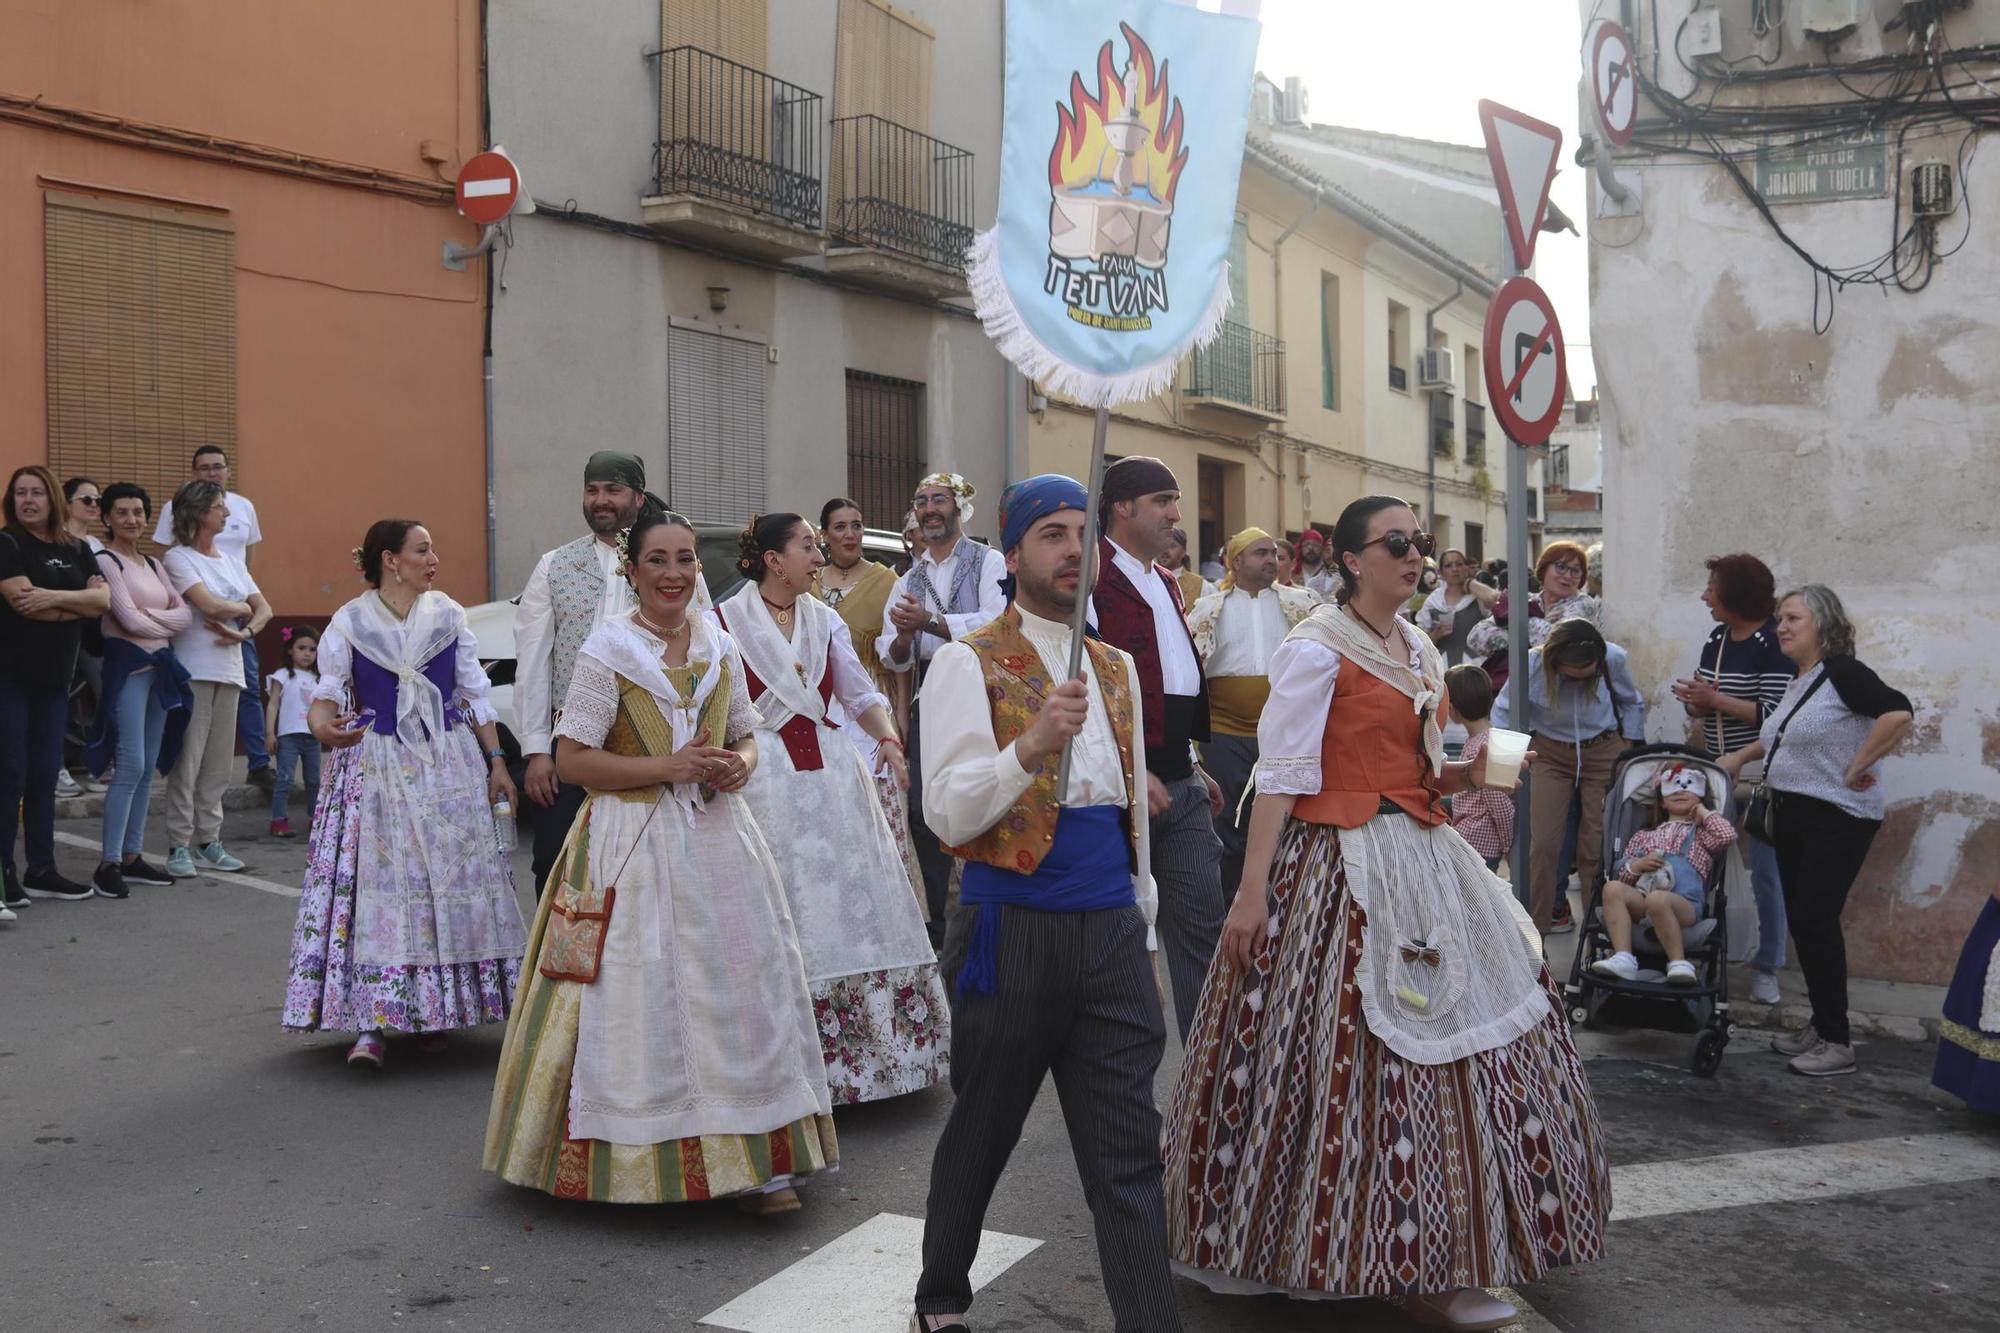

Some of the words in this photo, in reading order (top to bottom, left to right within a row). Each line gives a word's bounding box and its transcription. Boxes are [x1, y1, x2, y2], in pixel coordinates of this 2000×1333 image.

[1766, 170, 1817, 196] JOAQUIN
[1828, 167, 1875, 192] TUDELA
[1102, 254, 1136, 277] FALLA
